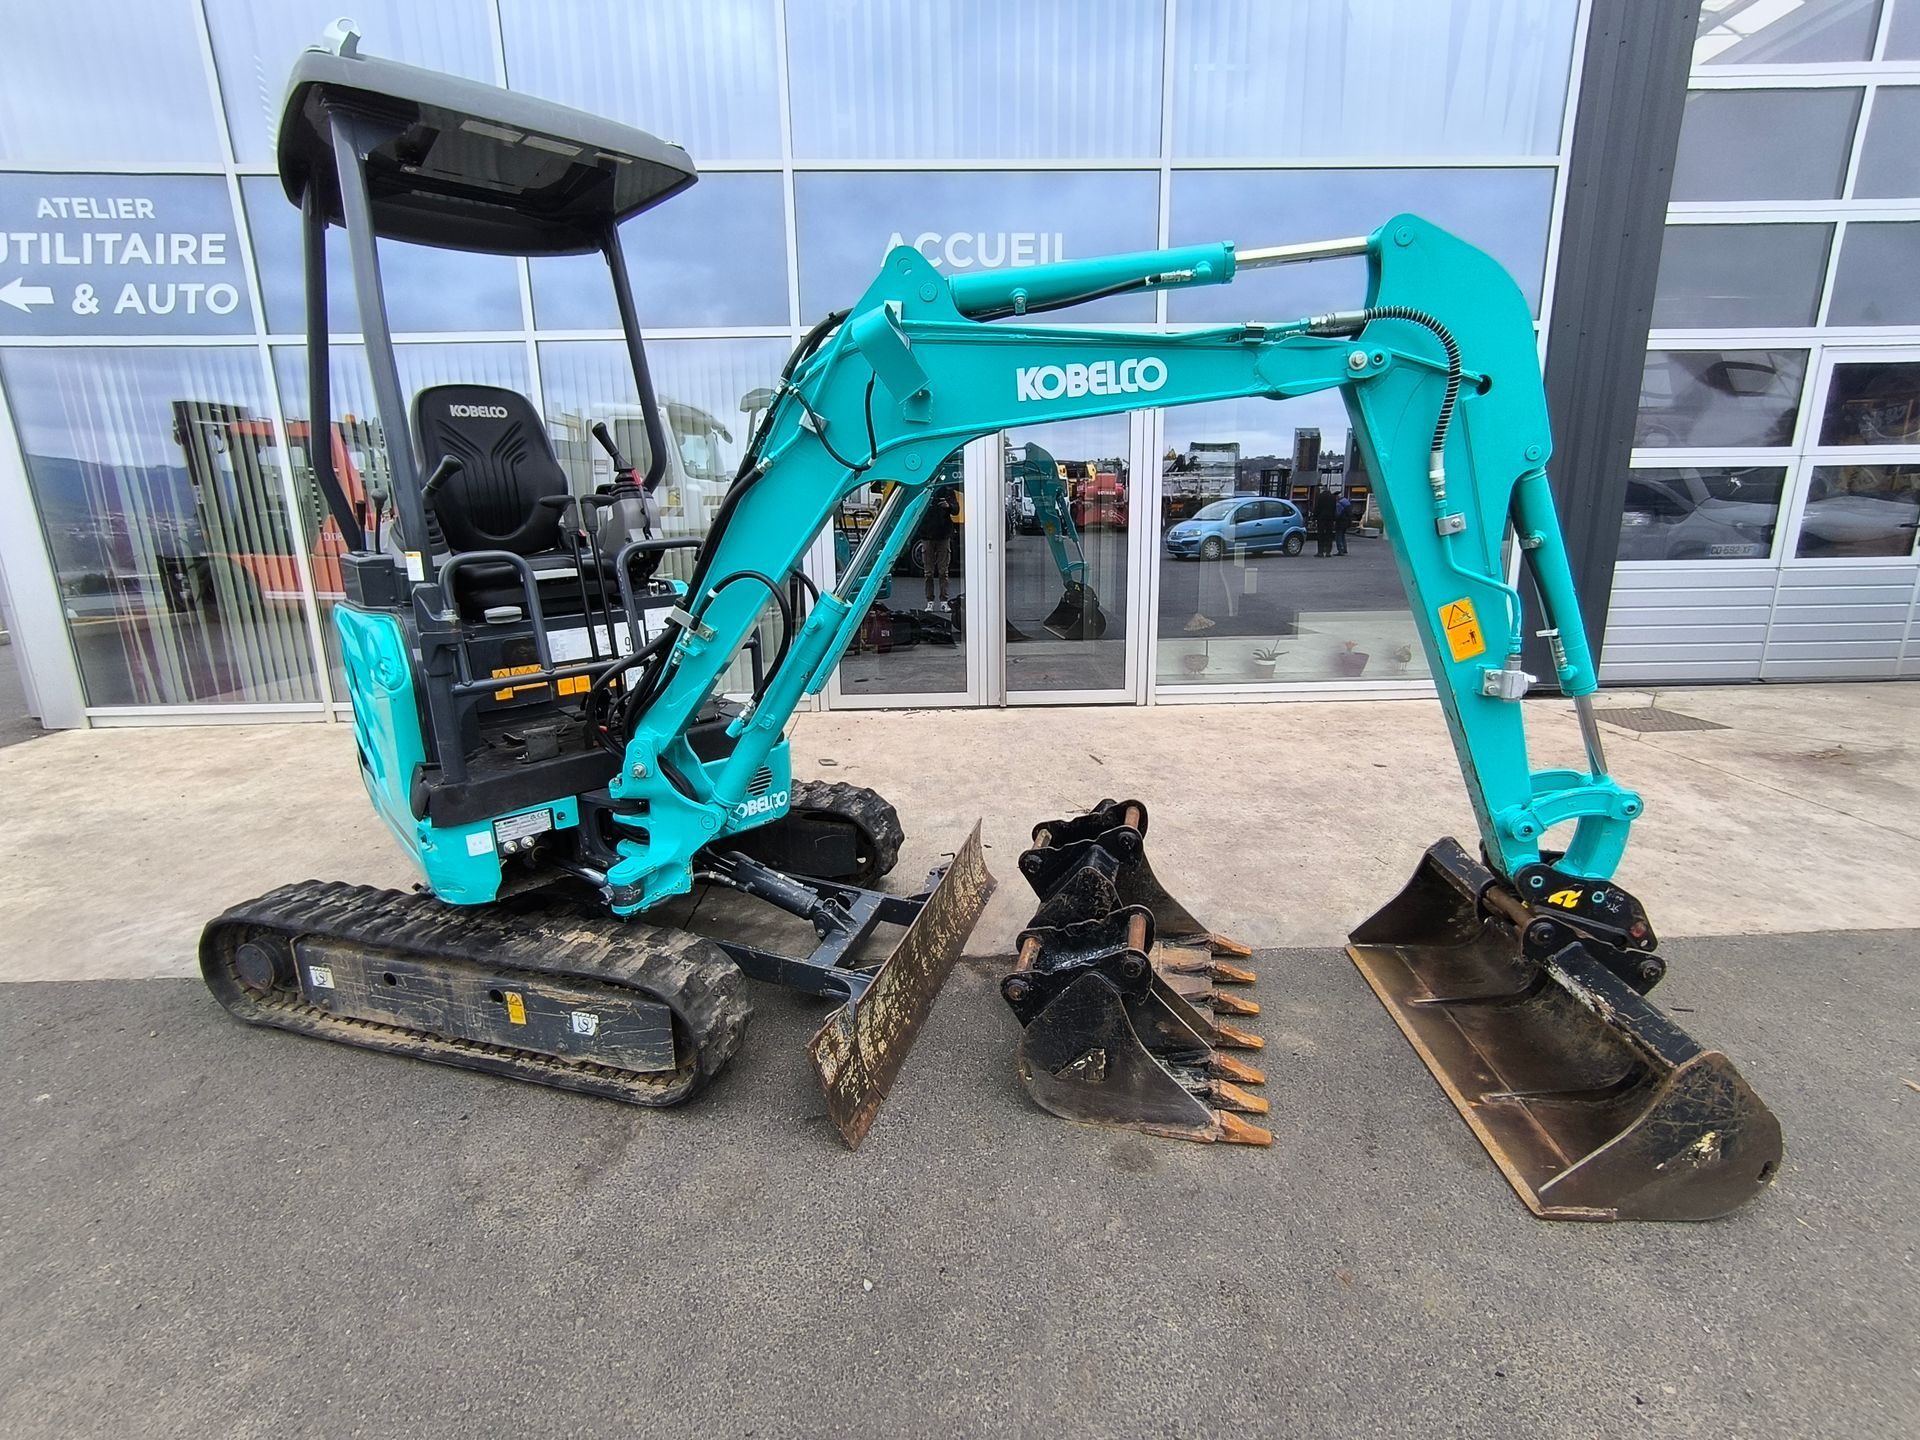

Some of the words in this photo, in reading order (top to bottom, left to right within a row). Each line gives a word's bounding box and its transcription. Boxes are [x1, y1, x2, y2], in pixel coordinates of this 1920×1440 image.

[37, 197, 155, 219] ATELIER
[0, 232, 226, 265] TILITAIRE
[71, 283, 100, 315] &
[113, 282, 239, 315] AUTO
[1016, 356, 1168, 402] KOBELCO
[449, 404, 508, 418] KOBELCO
[733, 790, 788, 818] OBELCO
